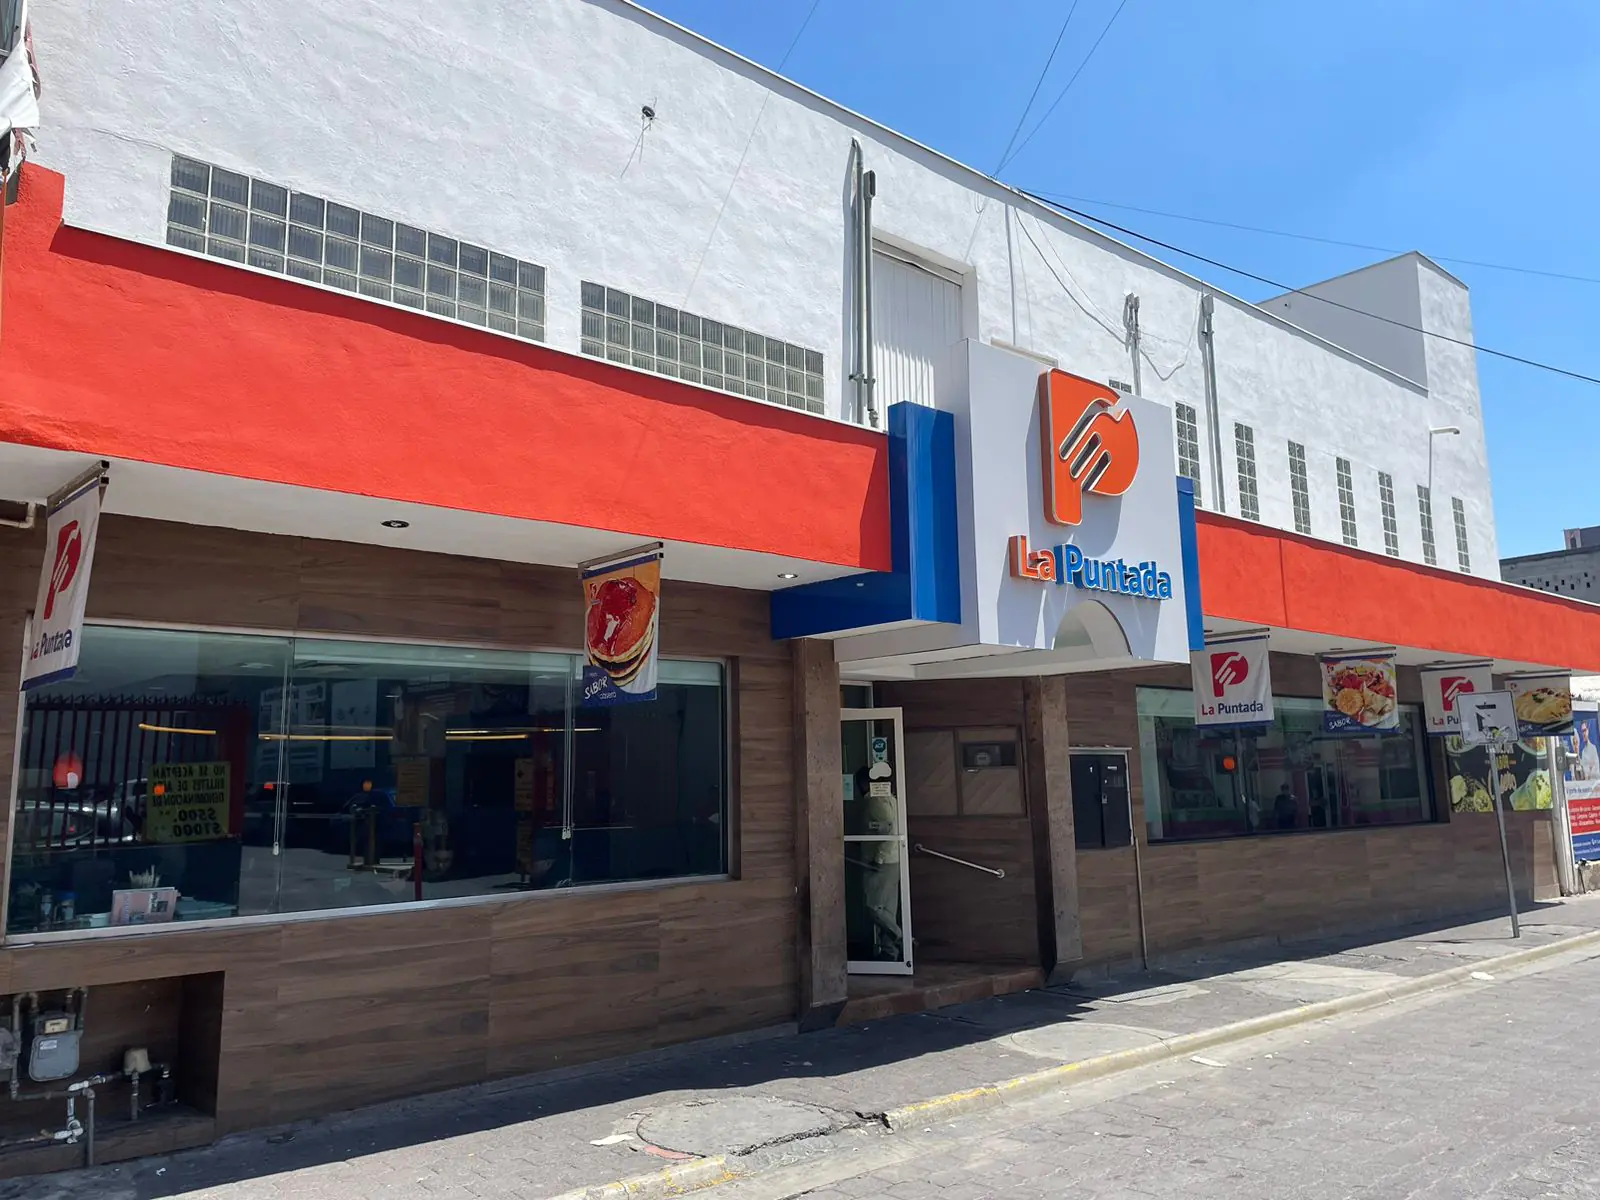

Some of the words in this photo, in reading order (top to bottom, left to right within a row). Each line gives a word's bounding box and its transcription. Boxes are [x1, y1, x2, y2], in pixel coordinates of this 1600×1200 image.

[1009, 535, 1056, 582] La
[1054, 543, 1172, 600] Puntada
[584, 676, 607, 699] SABOR
[1202, 704, 1215, 716] La
[1218, 701, 1264, 715] Puntada
[1329, 717, 1351, 730] SABOR
[1432, 716, 1444, 725] La
